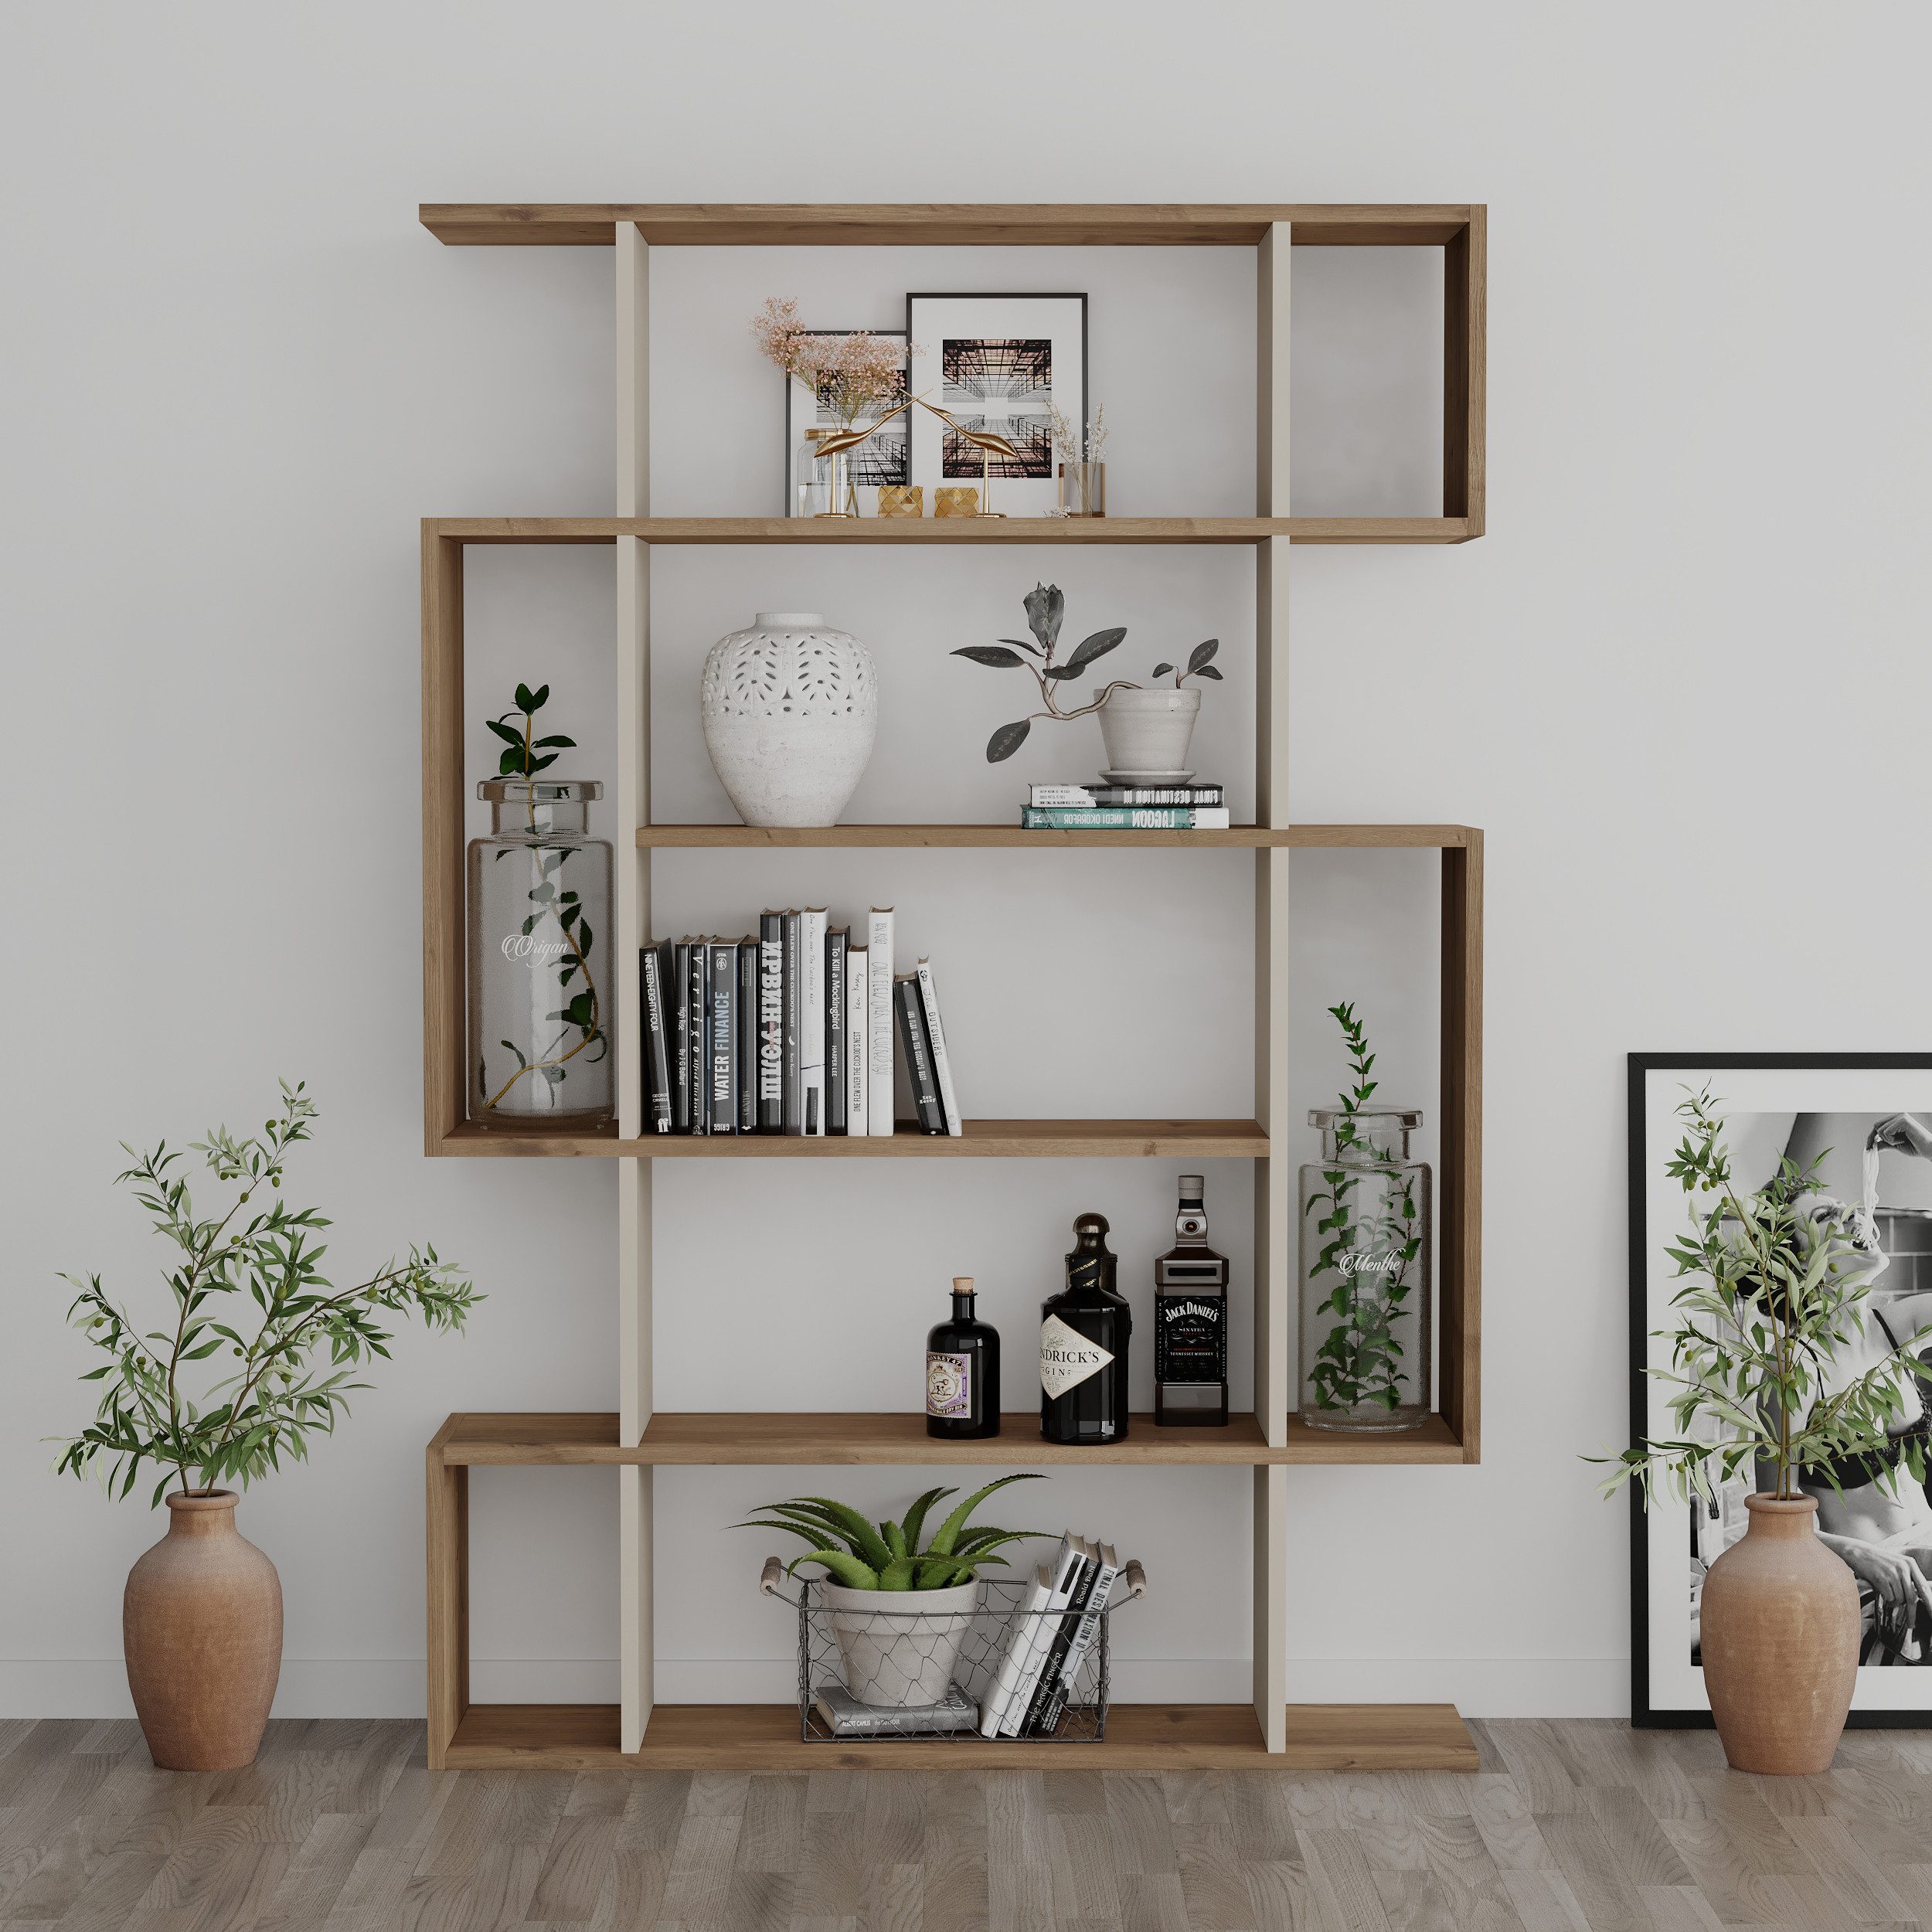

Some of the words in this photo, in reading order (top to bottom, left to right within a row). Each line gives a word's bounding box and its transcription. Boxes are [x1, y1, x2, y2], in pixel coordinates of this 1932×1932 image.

[501, 934, 570, 968] Origan
[832, 947, 840, 957] To
[761, 940, 782, 1023] ИРВИН
[677, 1006, 686, 1019] High
[691, 955, 703, 1053] Vertigo
[829, 980, 840, 1029] Mockingbird
[649, 1013, 659, 1032] FOUR
[715, 992, 729, 1051] FINANCE
[928, 1012, 942, 1057] OUTSIDERS
[715, 1055, 729, 1101] WATER
[760, 1028, 782, 1100] УОЛШ
[1338, 1247, 1406, 1278] Menthe
[1165, 1304, 1187, 1322] JACK
[1186, 1301, 1219, 1322] DANIEL'S
[1039, 1346, 1100, 1363] NDRICK'S
[1045, 1366, 1066, 1376] GIN
[1077, 1583, 1090, 1605] Roald
[1084, 1565, 1097, 1583] Dahl
[1090, 1568, 1114, 1590] FINAL
[1079, 1592, 1106, 1641] DESTNATION
[1046, 1652, 1063, 1681] FINGER
